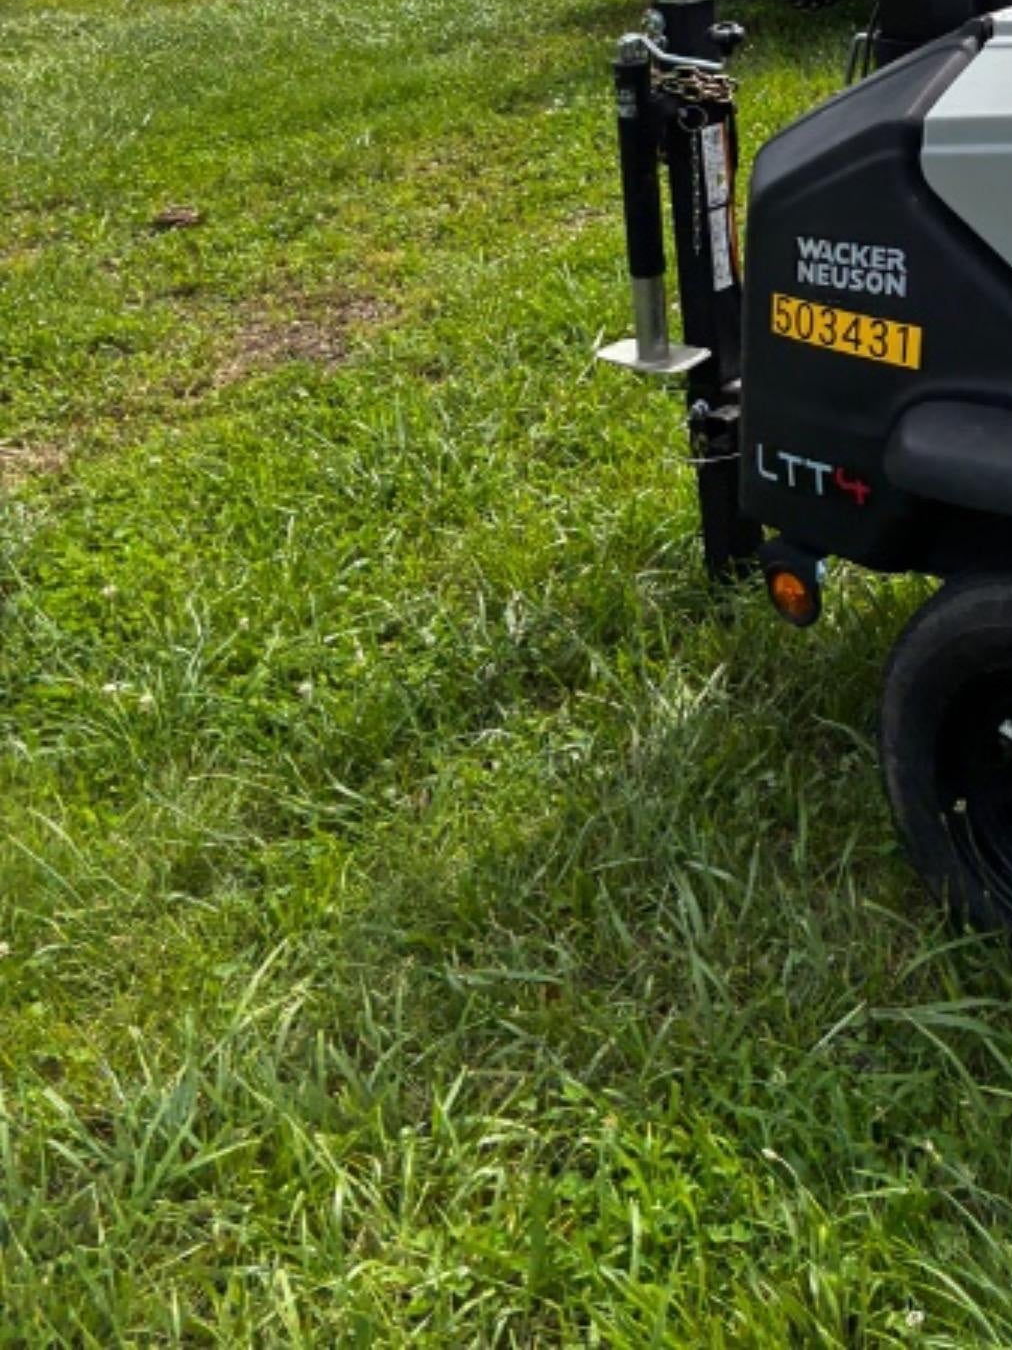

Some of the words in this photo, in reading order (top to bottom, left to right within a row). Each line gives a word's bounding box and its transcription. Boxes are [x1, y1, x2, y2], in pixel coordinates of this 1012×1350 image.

[797, 236, 907, 273] WACKER
[797, 260, 908, 298] NEUSON
[773, 297, 911, 364] 503431
[756, 444, 871, 504] LTT4
